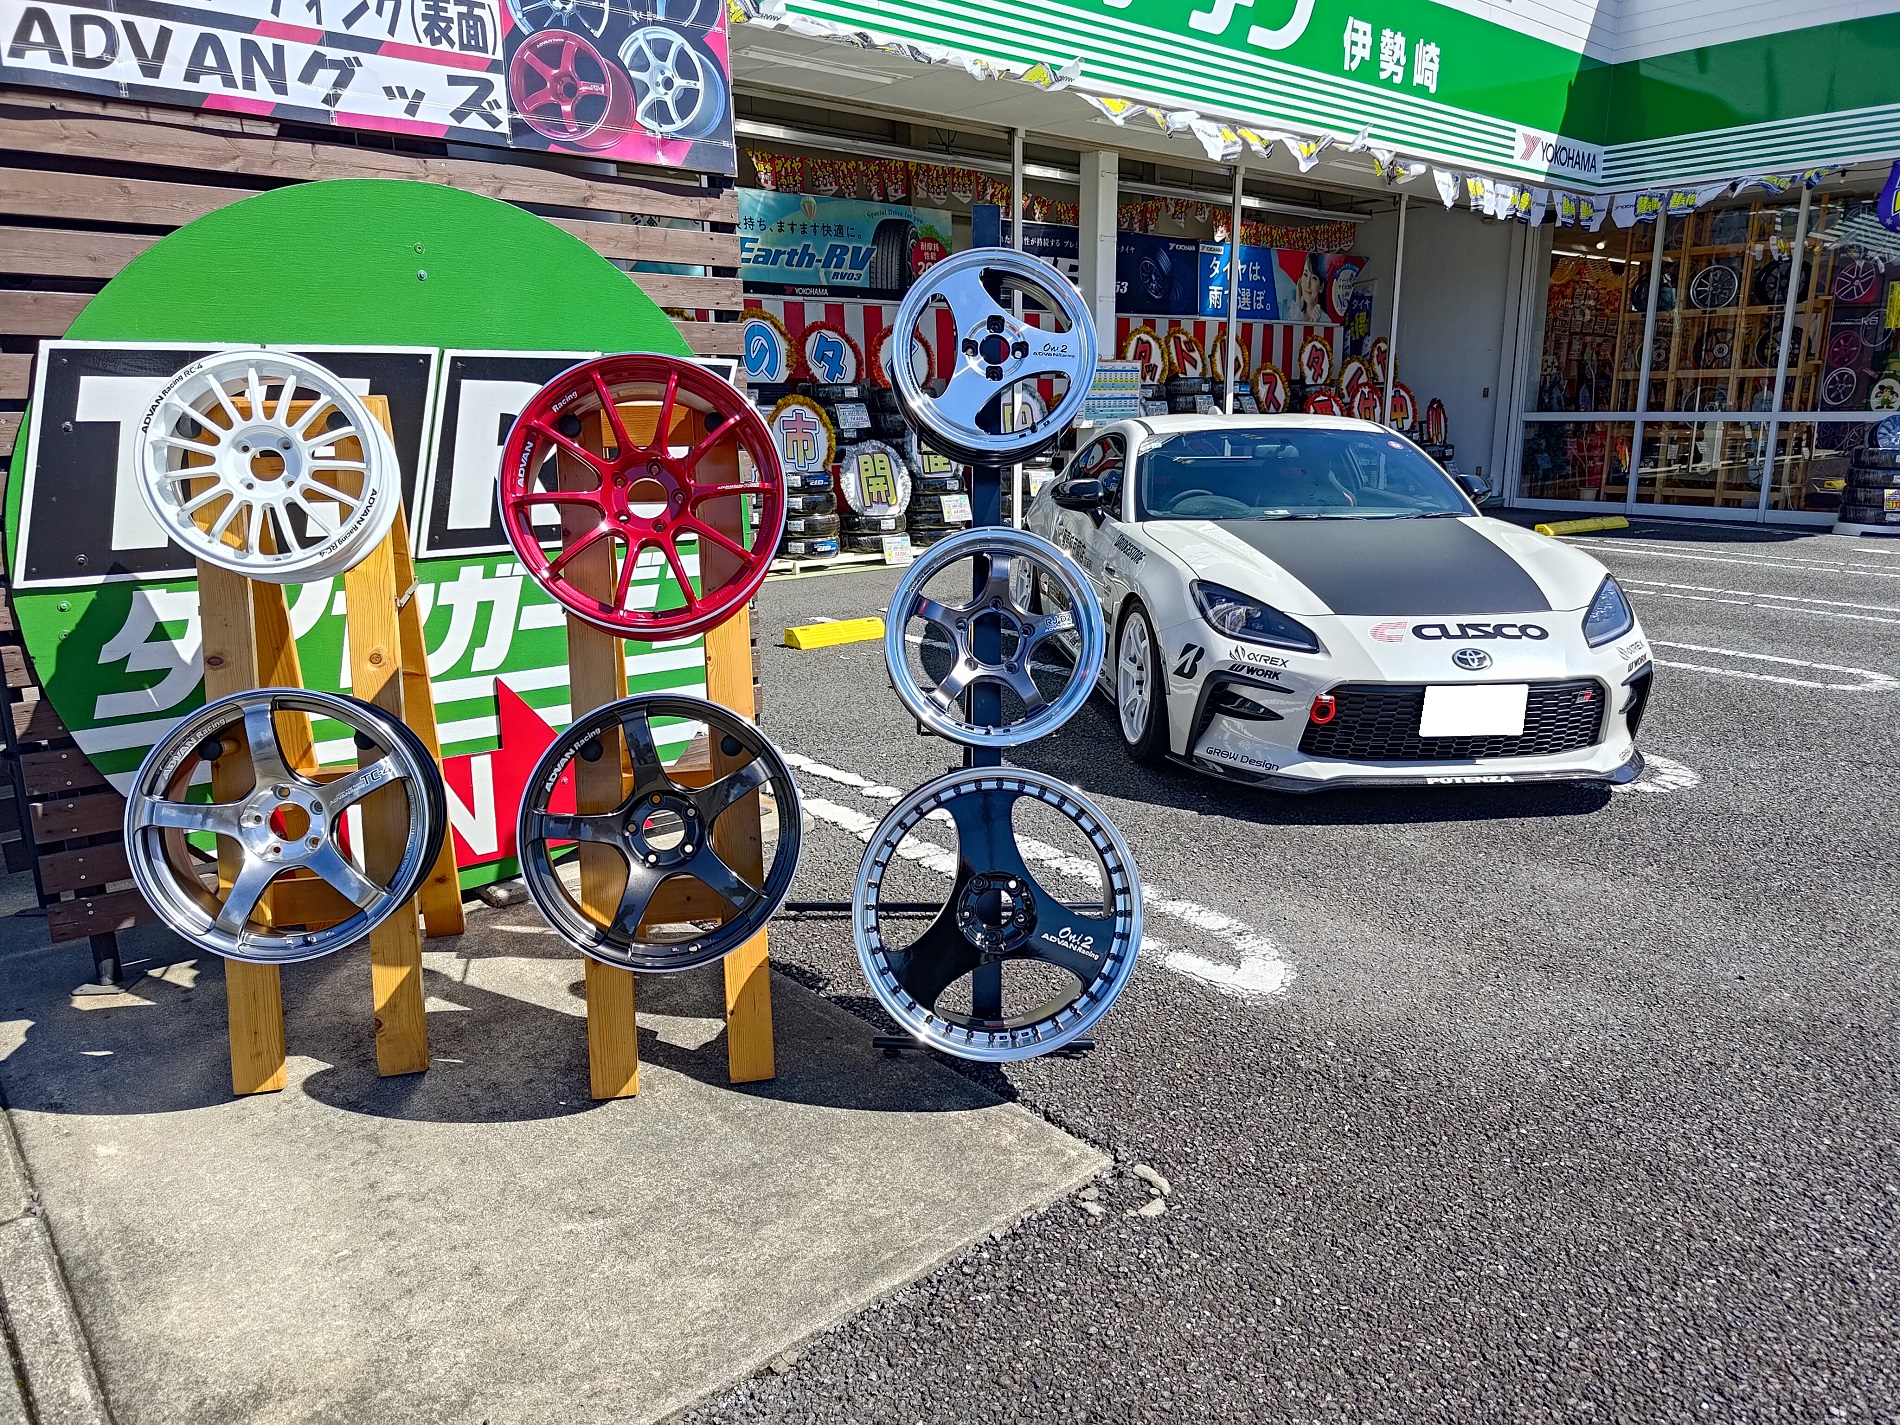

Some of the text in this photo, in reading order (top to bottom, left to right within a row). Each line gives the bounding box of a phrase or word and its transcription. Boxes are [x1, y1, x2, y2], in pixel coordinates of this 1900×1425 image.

[1343, 15, 1441, 94] 伊勢崎
[1540, 140, 1597, 174] YOKOHAMA
[867, 209, 887, 218] Special
[888, 208, 903, 217] Drive
[924, 252, 936, 261] 性能
[831, 271, 863, 281] RV03
[794, 287, 829, 296] YOKOHAMA
[1352, 299, 1371, 310] タイヤ
[140, 363, 204, 434] ADVAN Racing RC-4
[551, 389, 578, 414] Racing
[780, 408, 820, 472] 市
[517, 440, 535, 488] ADVAN
[857, 451, 898, 508] 開
[318, 488, 379, 558] ADVAN Racing RC-4
[1411, 622, 1549, 641] CUSCO
[1634, 653, 1648, 669] WORK
[1246, 665, 1282, 681] WORK
[161, 716, 228, 783] ADVAN Racing
[544, 727, 601, 793] ADVAN Racing
[1240, 755, 1280, 772] Design
[1426, 775, 1515, 785] POTENZA
